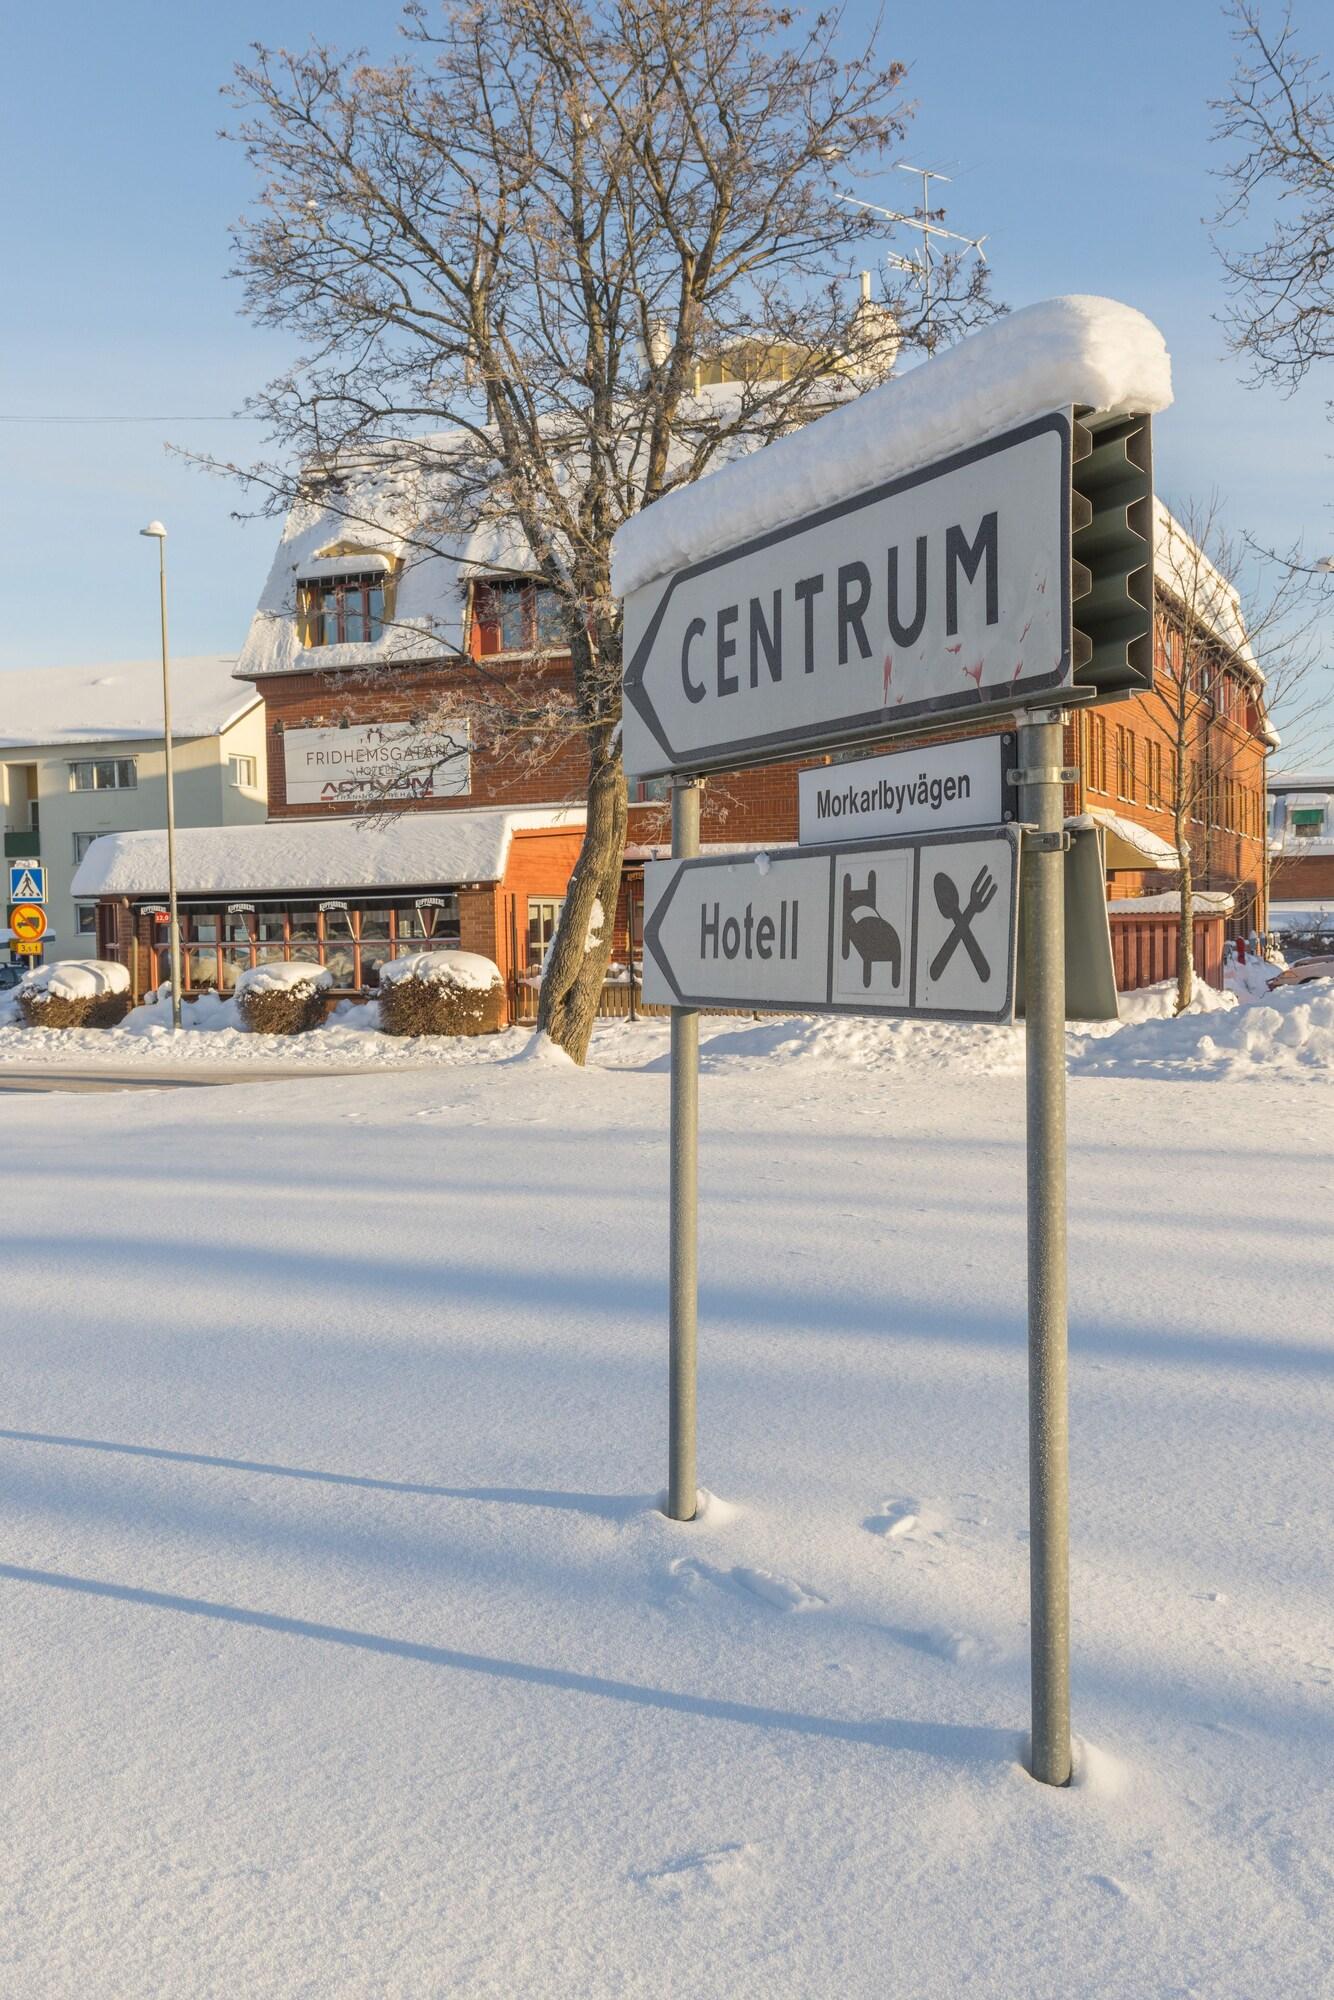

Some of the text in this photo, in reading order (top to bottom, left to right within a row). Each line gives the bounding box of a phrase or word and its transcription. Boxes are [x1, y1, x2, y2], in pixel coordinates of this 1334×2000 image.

[681, 511, 999, 704] CENTRUM
[306, 744, 448, 766] FRIDHEMSGATAN
[816, 773, 970, 819] Morkarlbyvägen
[700, 900, 798, 960] Hotell
